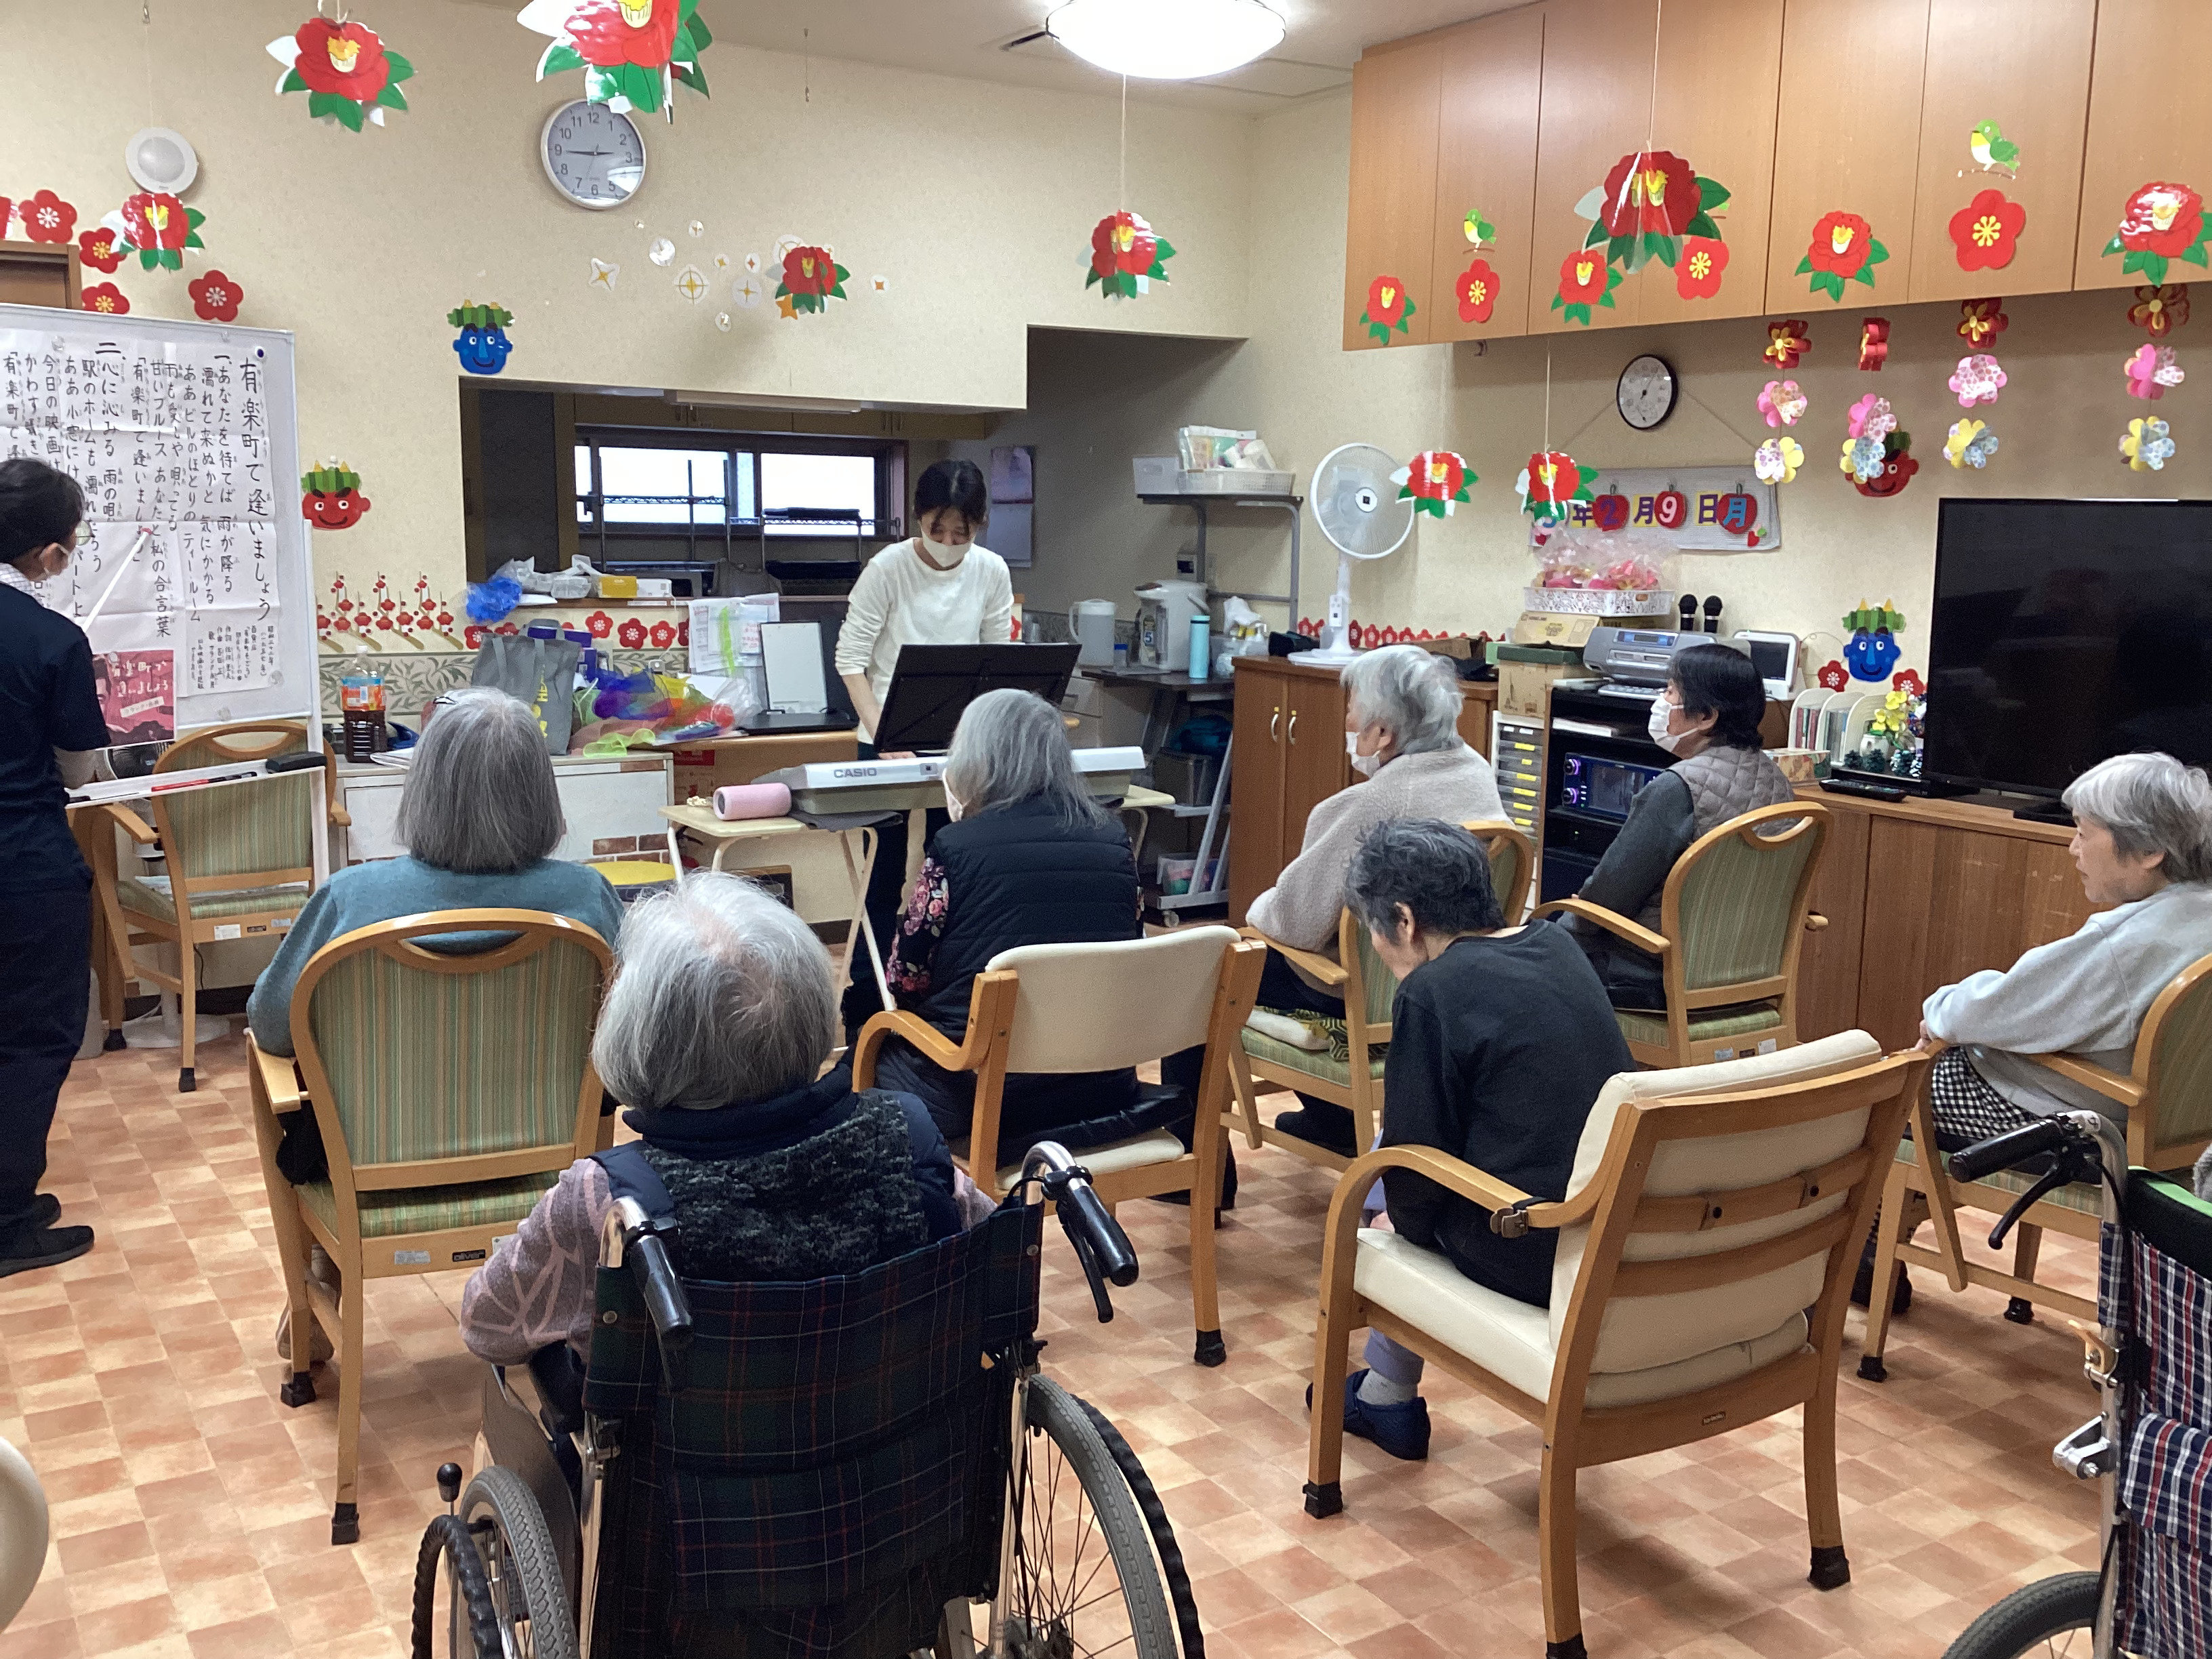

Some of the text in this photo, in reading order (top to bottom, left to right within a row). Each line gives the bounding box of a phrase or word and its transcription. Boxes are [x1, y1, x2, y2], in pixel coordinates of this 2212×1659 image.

[571, 115, 582, 128] 11
[587, 112, 600, 124] 12
[608, 120, 613, 131] 1
[560, 127, 572, 140] 10
[619, 134, 627, 146] 2
[554, 144, 562, 156] 9
[625, 151, 633, 163] 3
[560, 163, 568, 175] 8
[575, 177, 582, 189] 7
[608, 180, 616, 192] 5
[591, 184, 599, 196] 6
[240, 356, 270, 621] 有楽町で逢いましょう
[1145, 632, 1152, 643] 5
[834, 767, 877, 778] CASIO
